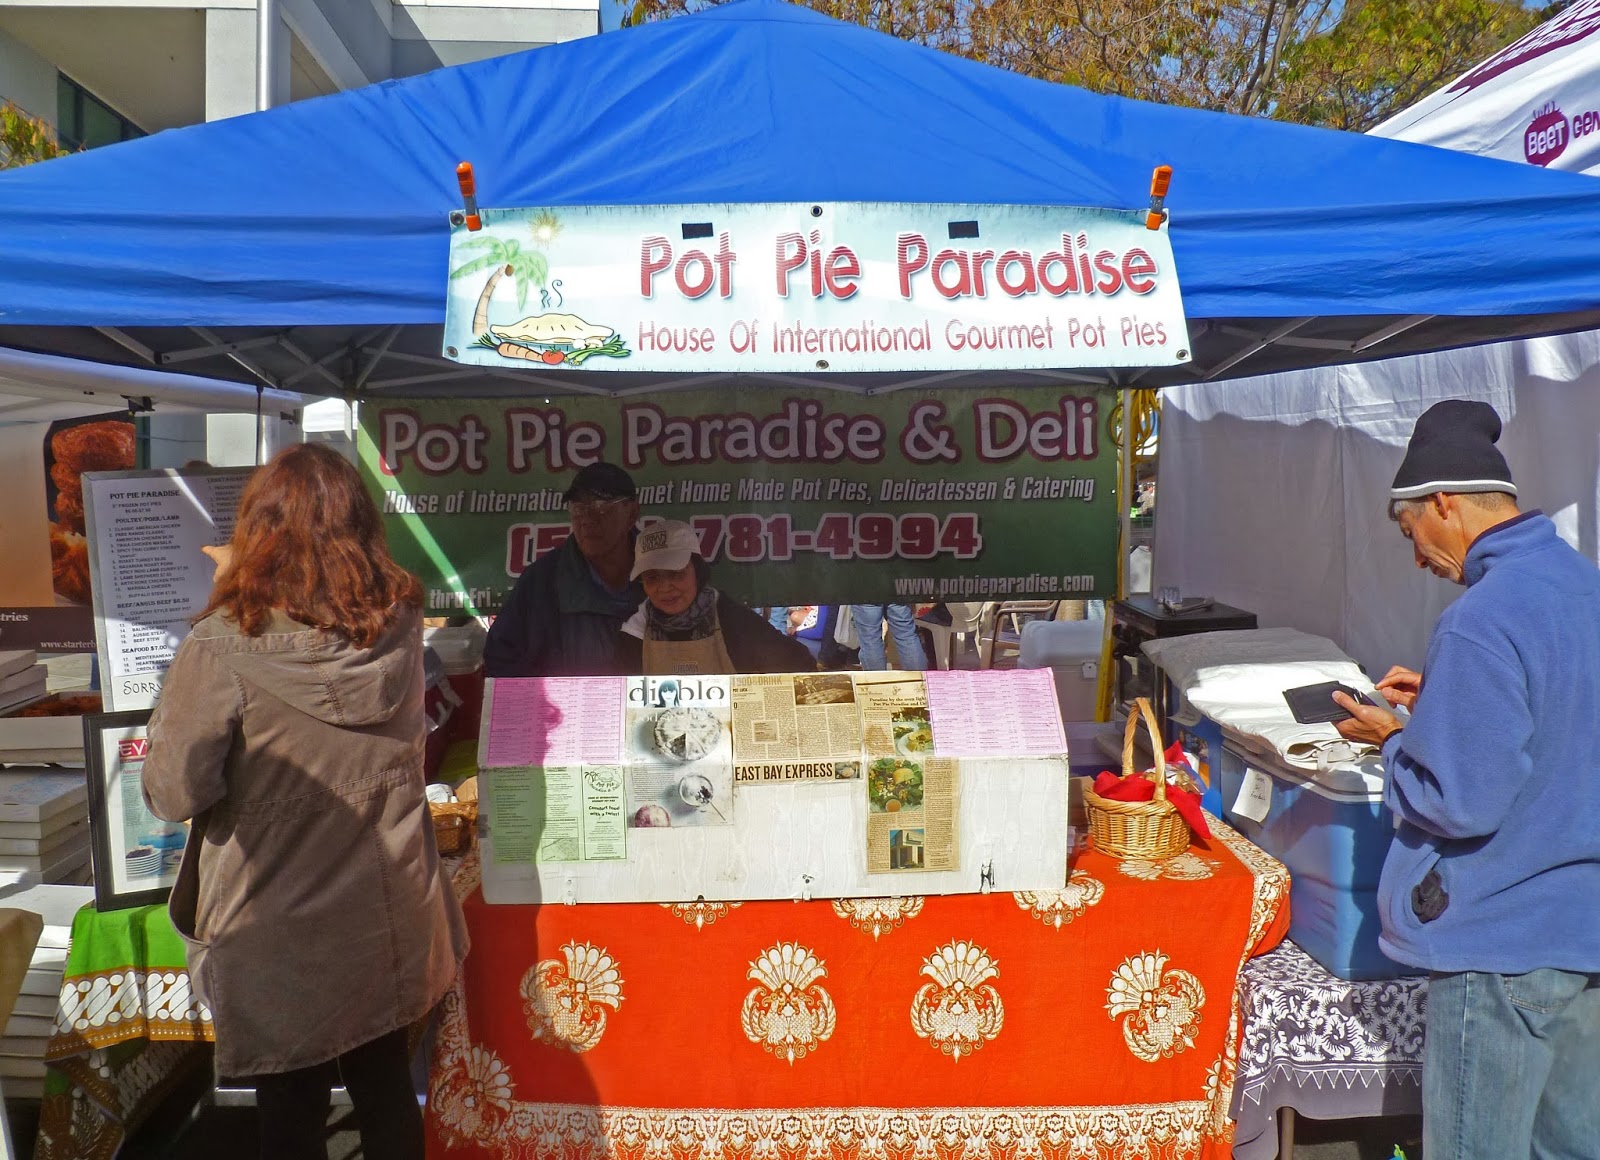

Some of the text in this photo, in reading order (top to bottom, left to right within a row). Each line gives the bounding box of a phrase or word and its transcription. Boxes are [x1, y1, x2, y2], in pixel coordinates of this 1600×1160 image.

[641, 230, 1157, 298] Pot Pie Paradise
[639, 314, 1167, 353] House Of International Gourmet Pot Pies
[382, 399, 1096, 473] Pot Pie Paradise & Deli
[141, 490, 180, 498] PARADISE
[383, 490, 438, 514] House
[446, 490, 464, 513] of
[470, 488, 569, 512] Internatio
[680, 480, 731, 504] Home
[738, 478, 784, 501] Made
[791, 478, 821, 500] Pot
[827, 478, 871, 503] Pies,
[880, 478, 997, 500] Delicatessen
[1002, 478, 1016, 499] &
[1020, 476, 1094, 500] Catering
[643, 532, 666, 544] URBAN
[691, 513, 981, 561] 781-4994
[895, 574, 1094, 597] www.potpieparadise.com
[0, 612, 28, 622] tries
[630, 676, 724, 703] diblo
[735, 763, 833, 780] EAST BAY EXPRESS
